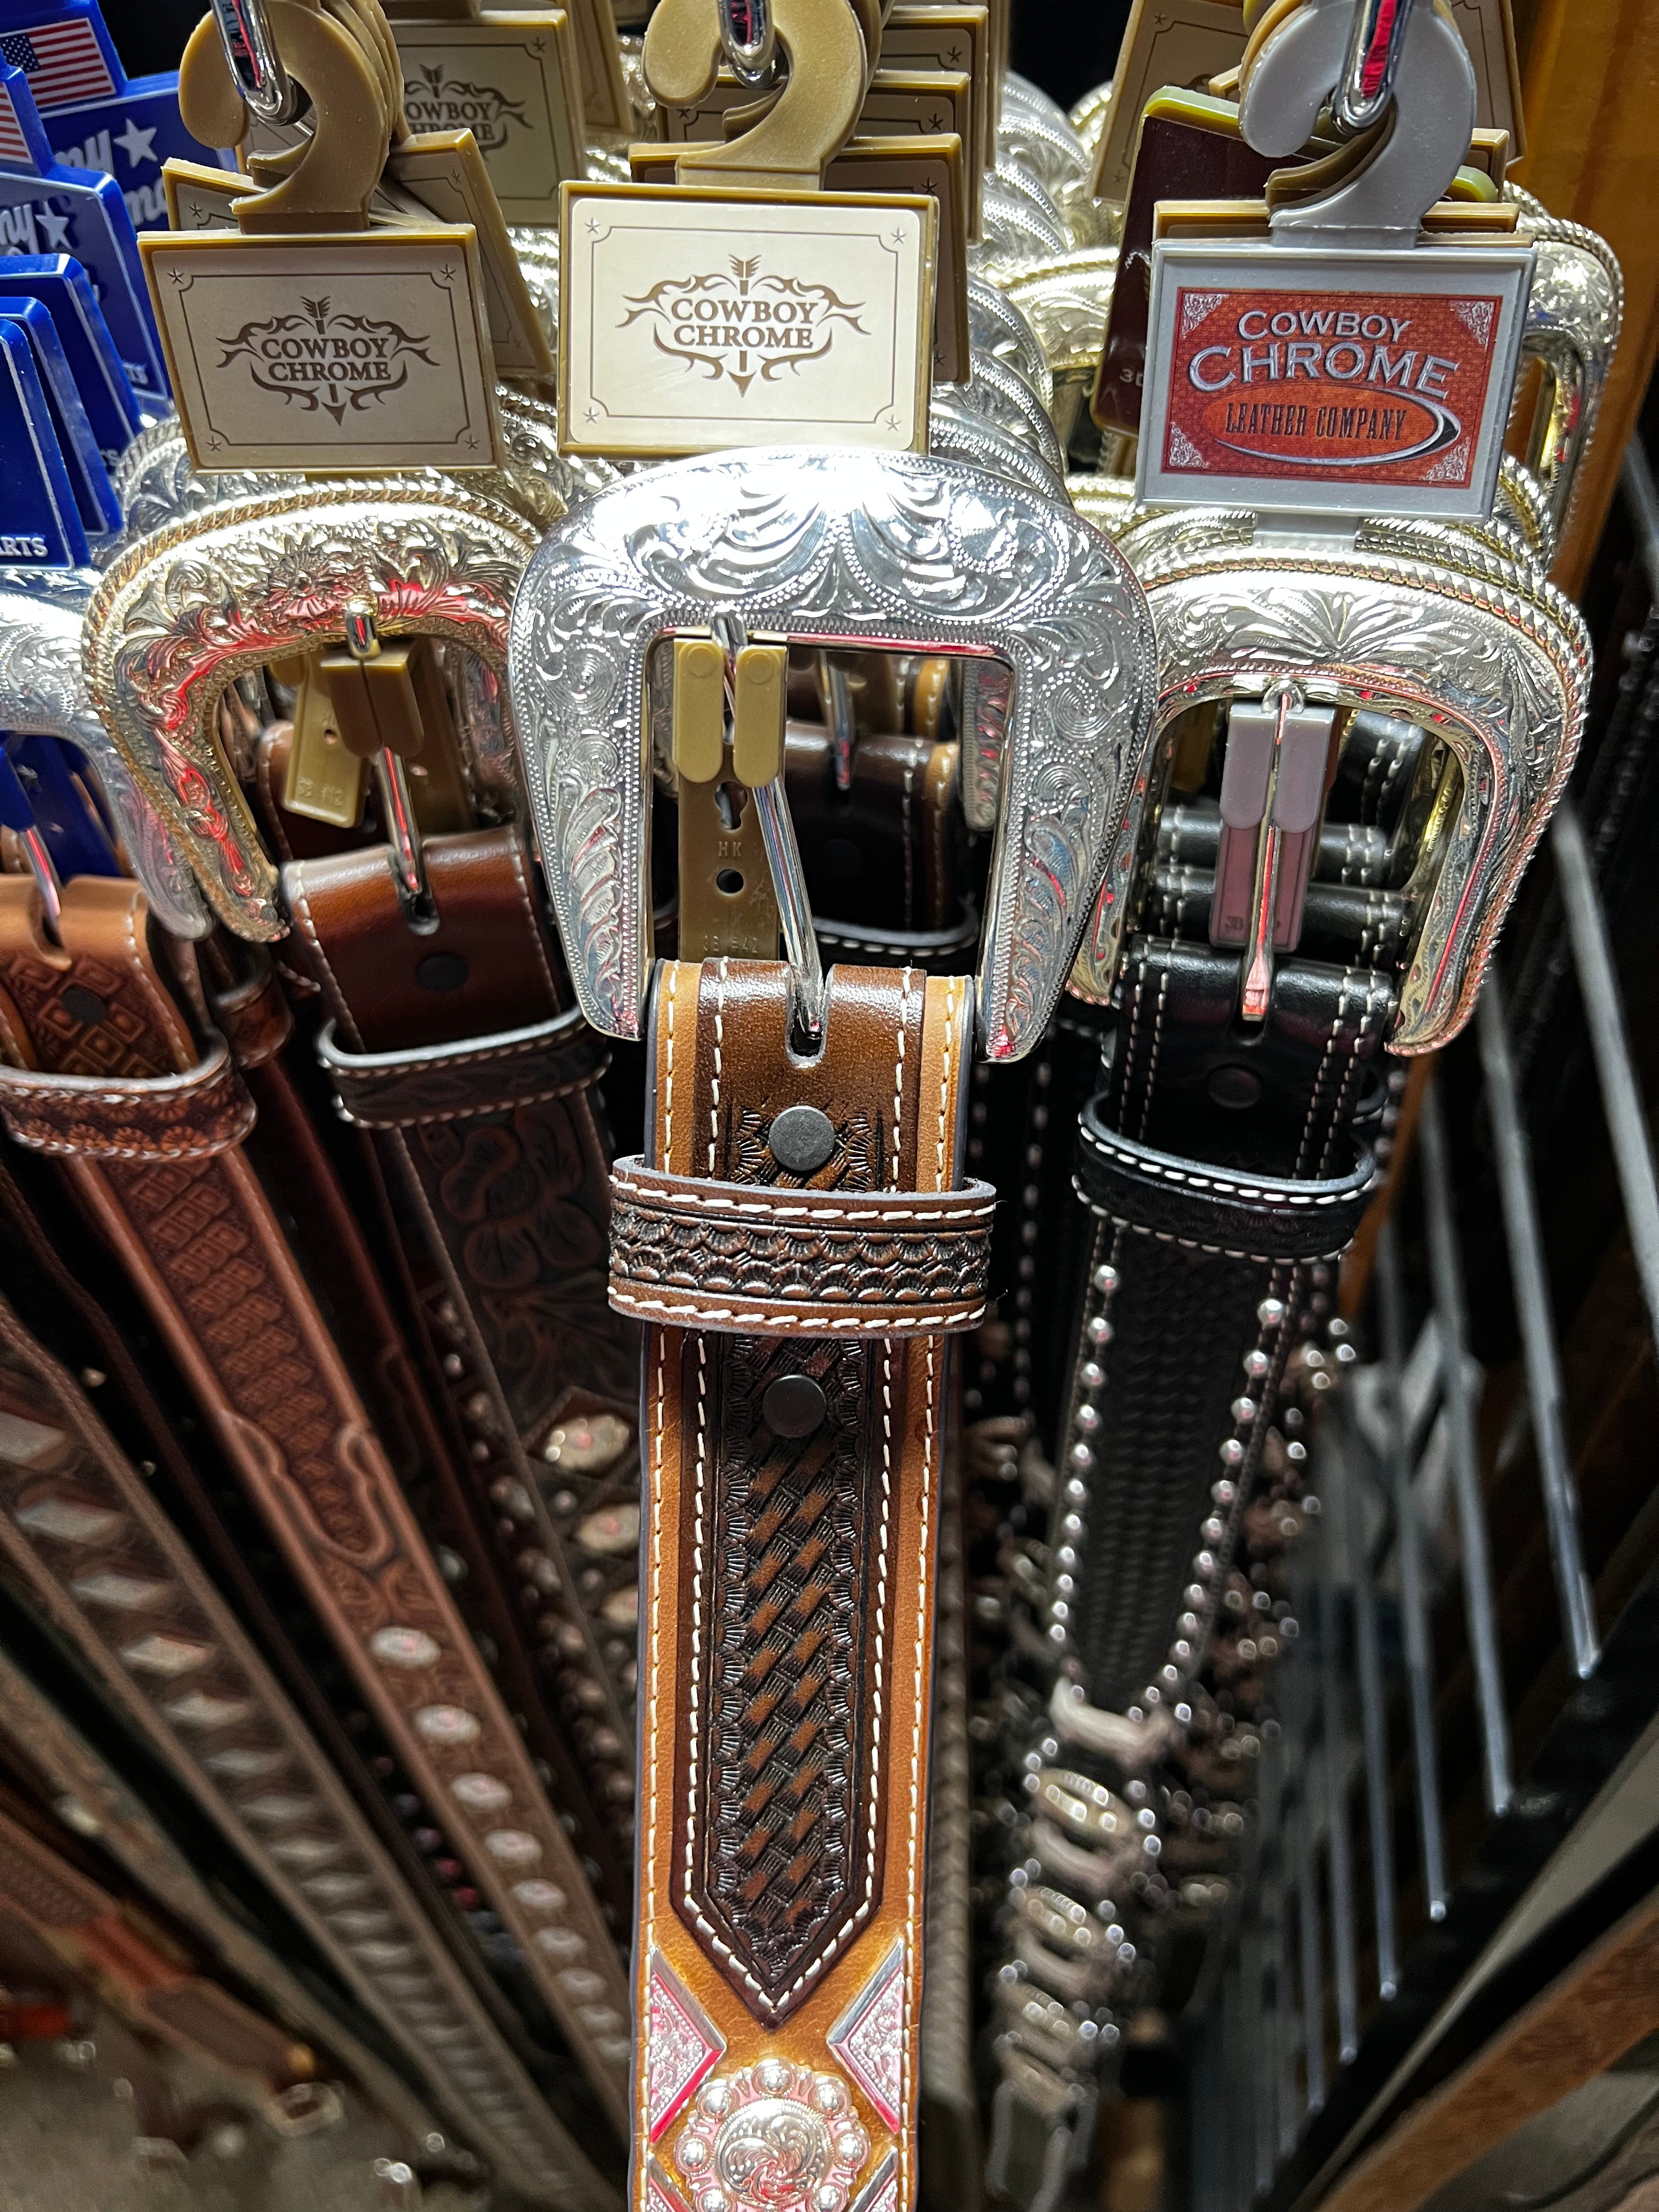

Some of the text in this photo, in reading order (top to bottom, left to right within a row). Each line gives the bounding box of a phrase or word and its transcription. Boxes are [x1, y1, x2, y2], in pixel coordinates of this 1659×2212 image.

[405, 101, 492, 120] OWBOY
[671, 298, 819, 324] COWBOY
[674, 324, 814, 348] CHROME
[1238, 310, 1413, 343] COWBOY
[261, 337, 389, 359] COWBOY
[268, 361, 392, 382] CHROME
[1188, 341, 1460, 400] CHROME
[1226, 402, 1407, 440] LEATHER COMPANY
[0, 536, 48, 557] RTS
[718, 840, 742, 857] HK
